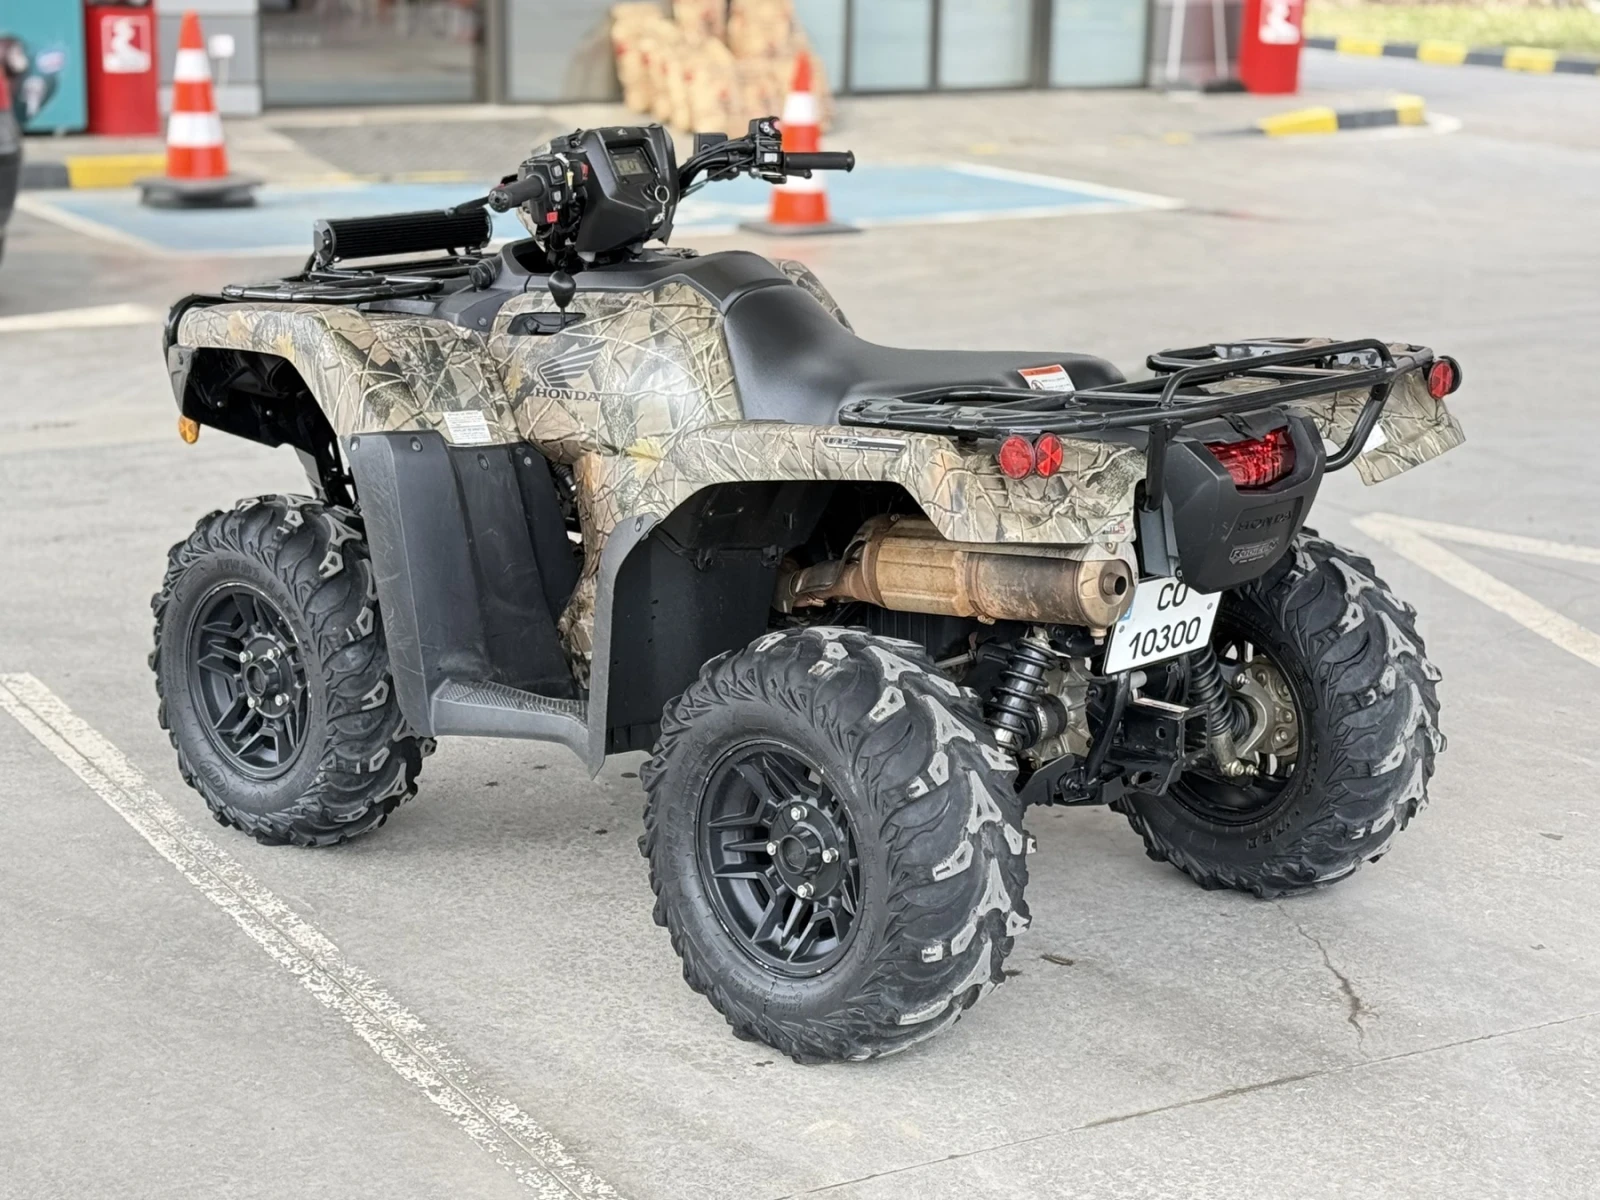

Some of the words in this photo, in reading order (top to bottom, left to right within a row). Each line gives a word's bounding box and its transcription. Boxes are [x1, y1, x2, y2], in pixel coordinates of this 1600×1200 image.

[535, 387, 600, 402] HONDA
[1237, 510, 1292, 531] HONDA
[1157, 581, 1189, 611] CO
[1128, 616, 1202, 660] 10300
